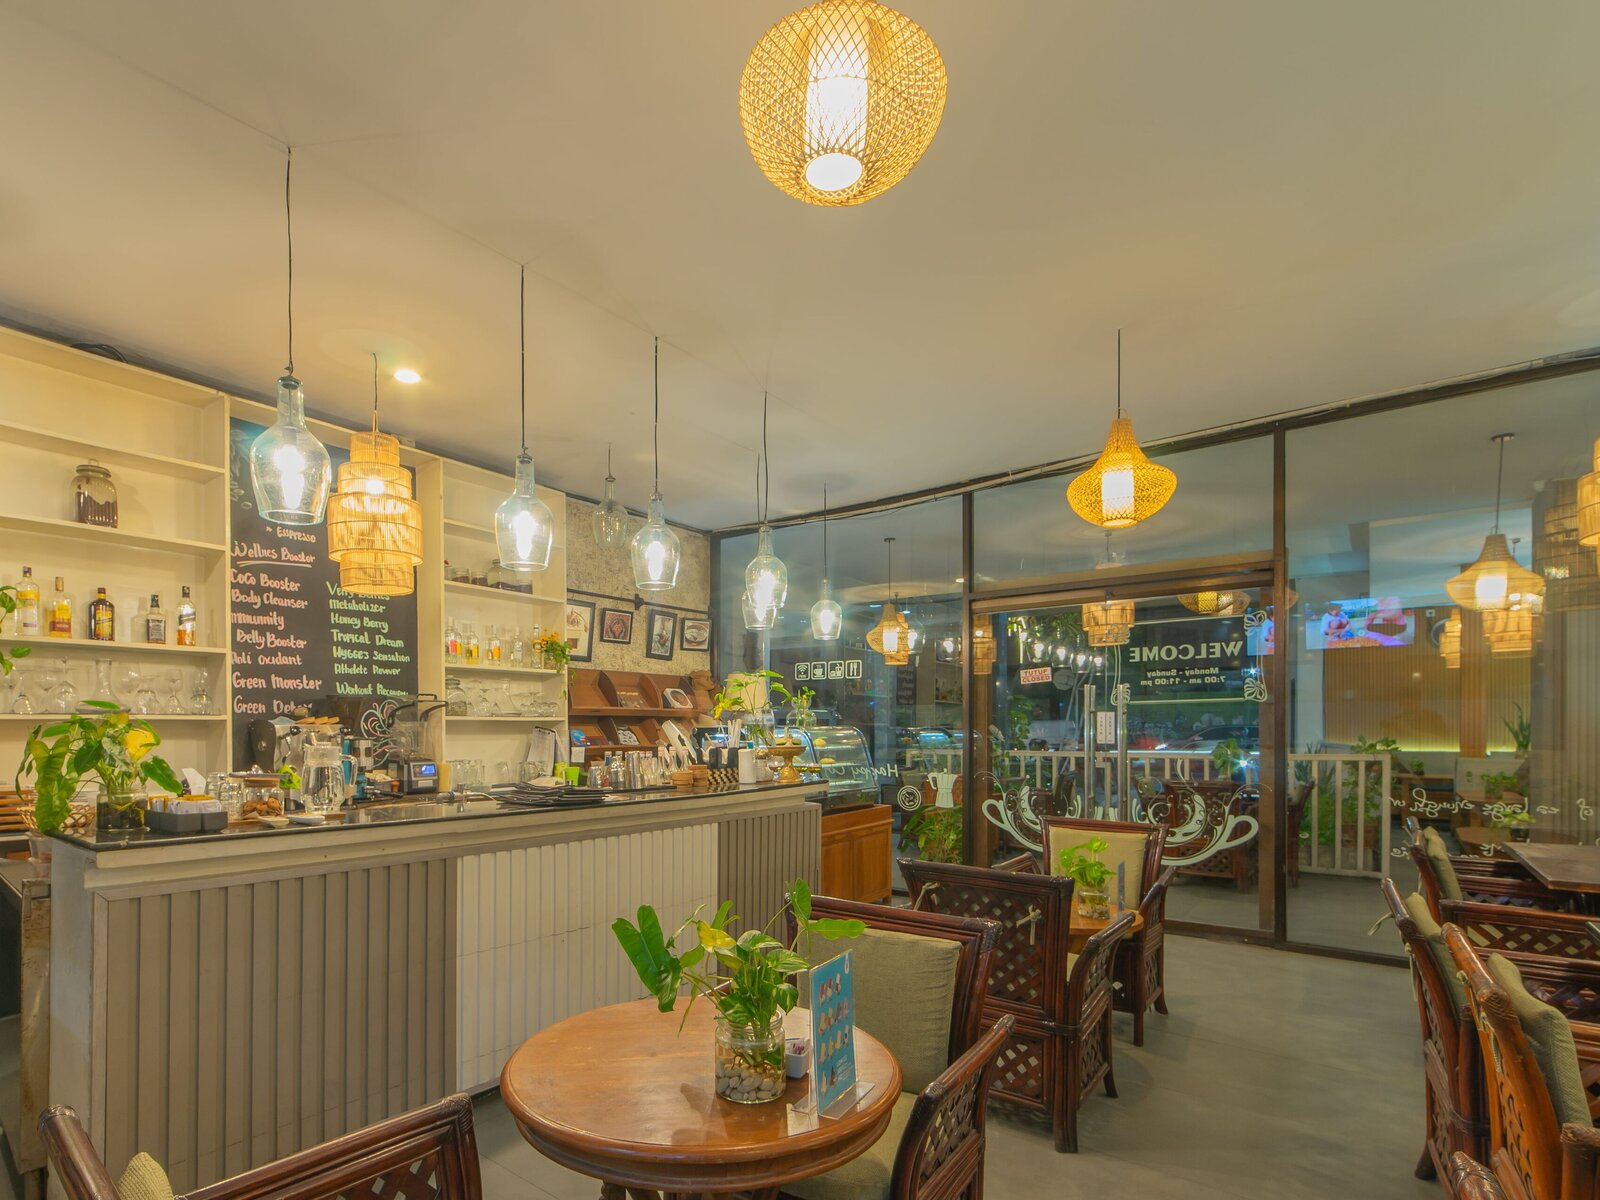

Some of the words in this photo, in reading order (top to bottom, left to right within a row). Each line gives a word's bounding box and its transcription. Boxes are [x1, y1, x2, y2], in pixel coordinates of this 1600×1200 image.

[260, 572, 300, 592] Booster
[231, 589, 261, 609] Body
[263, 592, 308, 609] Cleanser
[331, 612, 361, 629] Honey
[363, 619, 389, 633] Berry
[236, 629, 265, 649] Belly
[266, 631, 307, 649] Booster
[375, 635, 404, 648] Dream
[232, 671, 267, 689] Green
[1024, 668, 1048, 676] TUTUP
[233, 695, 266, 714] Green
[273, 699, 313, 714] Det
